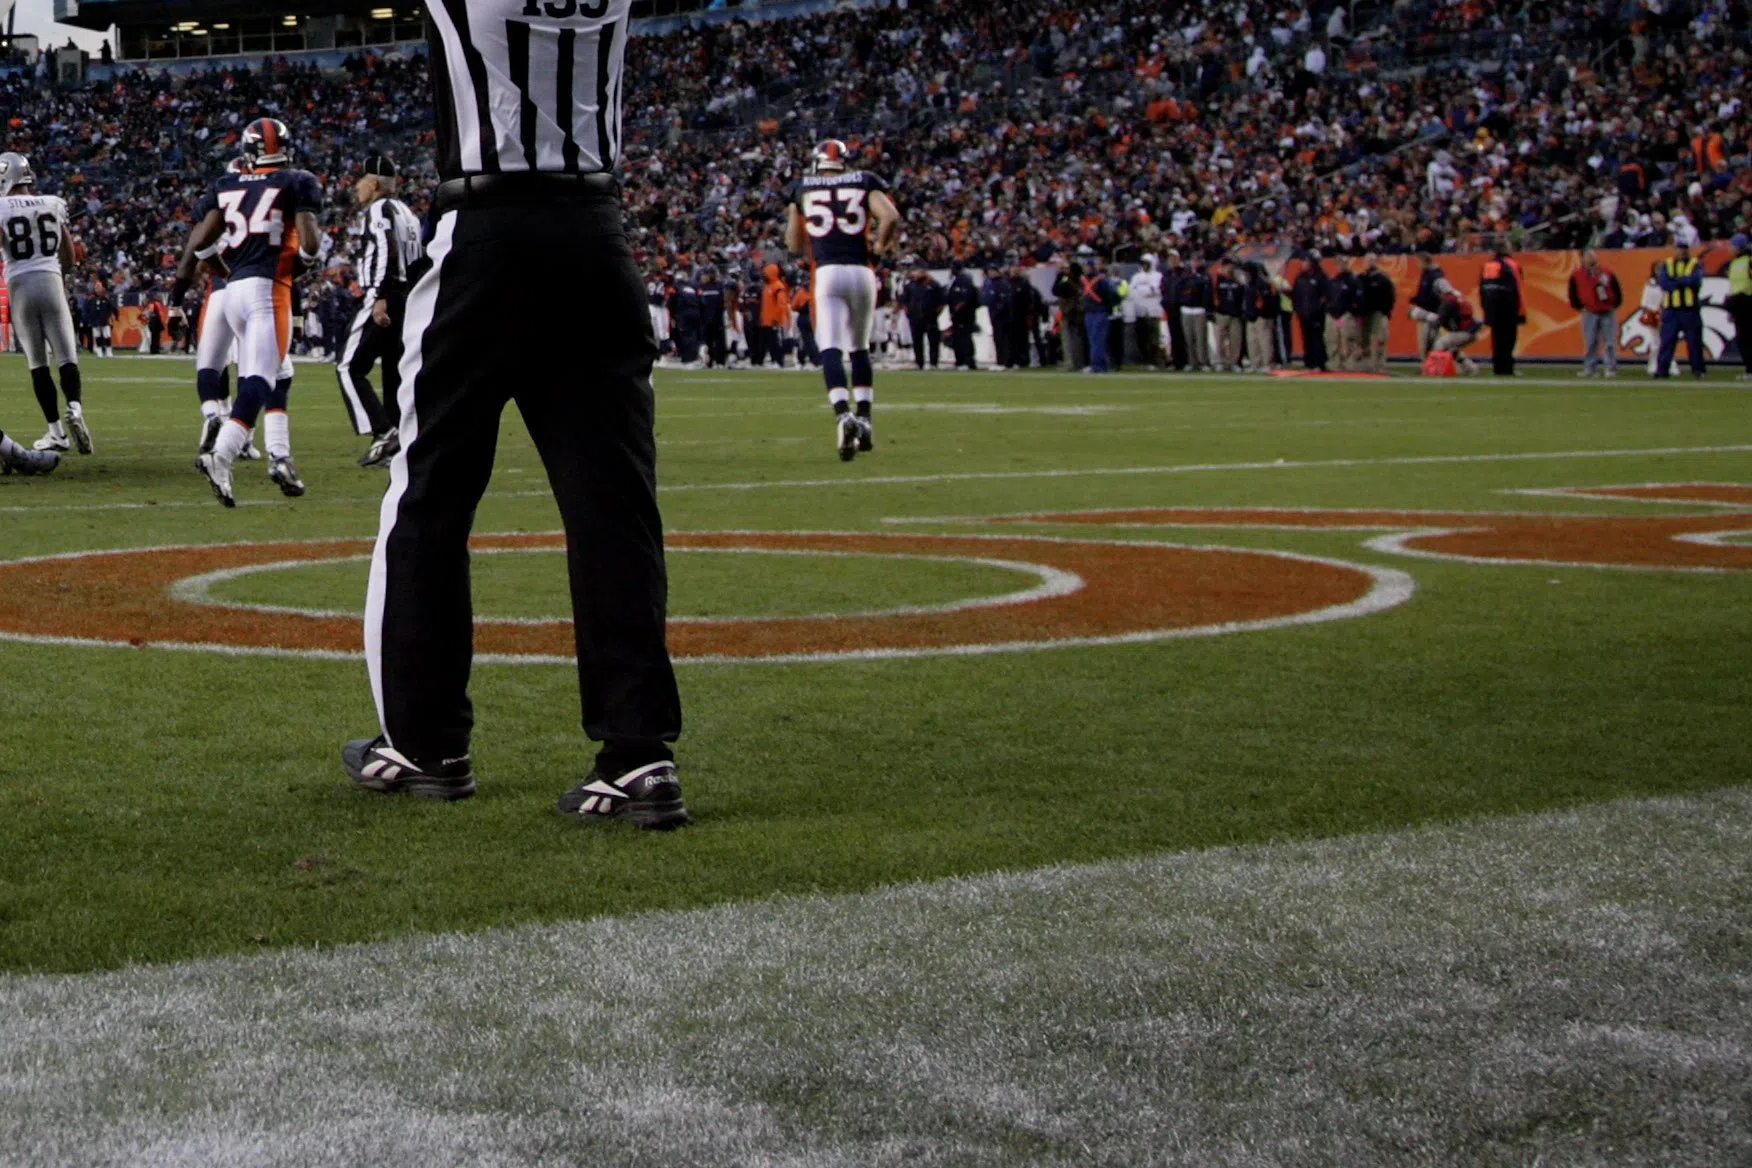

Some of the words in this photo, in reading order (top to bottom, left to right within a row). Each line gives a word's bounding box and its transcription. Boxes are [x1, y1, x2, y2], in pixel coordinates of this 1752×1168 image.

[7, 213, 58, 260] 86
[217, 188, 285, 249] 34
[802, 188, 867, 237] 53
